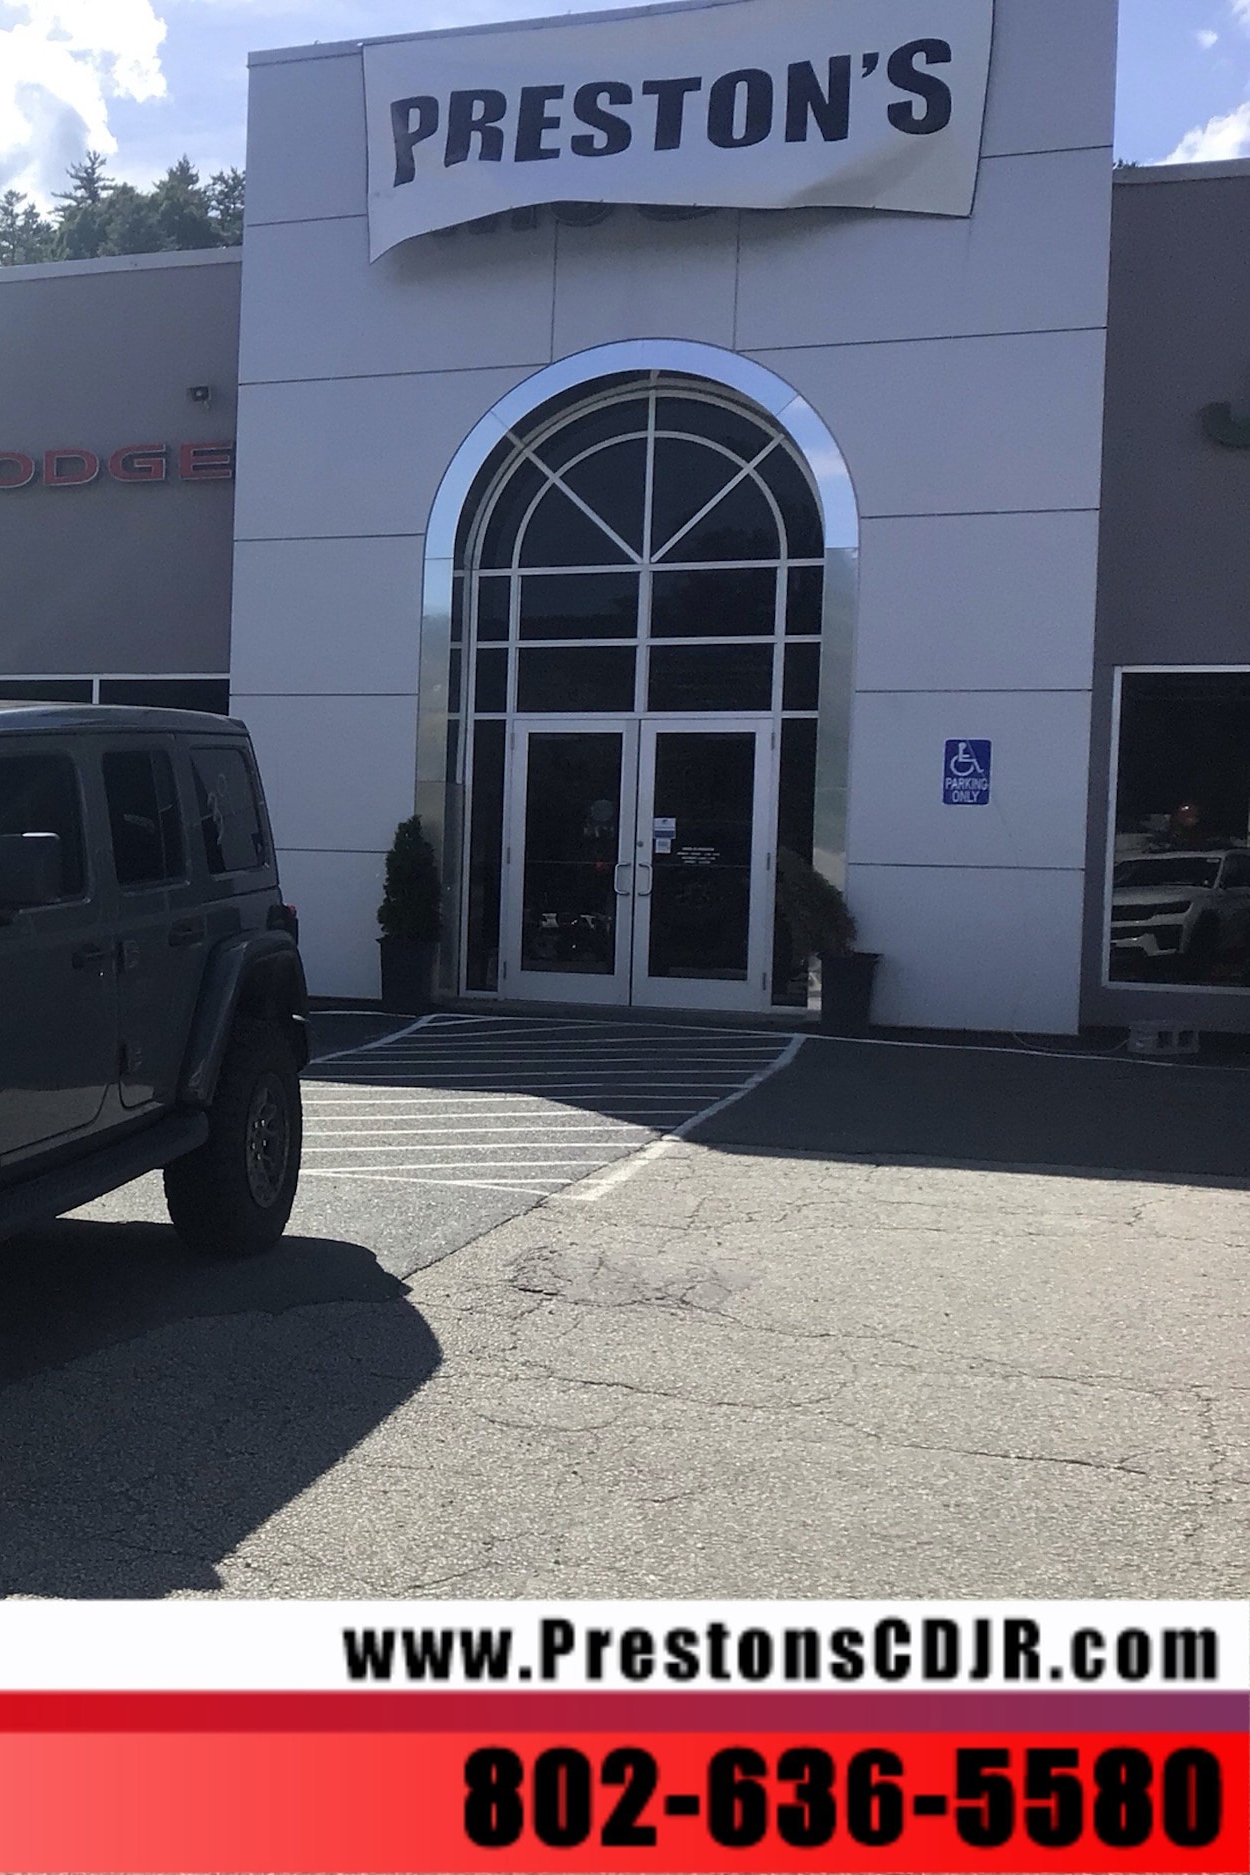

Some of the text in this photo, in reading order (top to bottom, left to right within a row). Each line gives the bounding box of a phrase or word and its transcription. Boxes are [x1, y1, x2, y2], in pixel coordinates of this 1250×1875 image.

[390, 37, 952, 188] PRESTON'S
[945, 777, 989, 790] PARKING
[951, 790, 980, 803] ONLY
